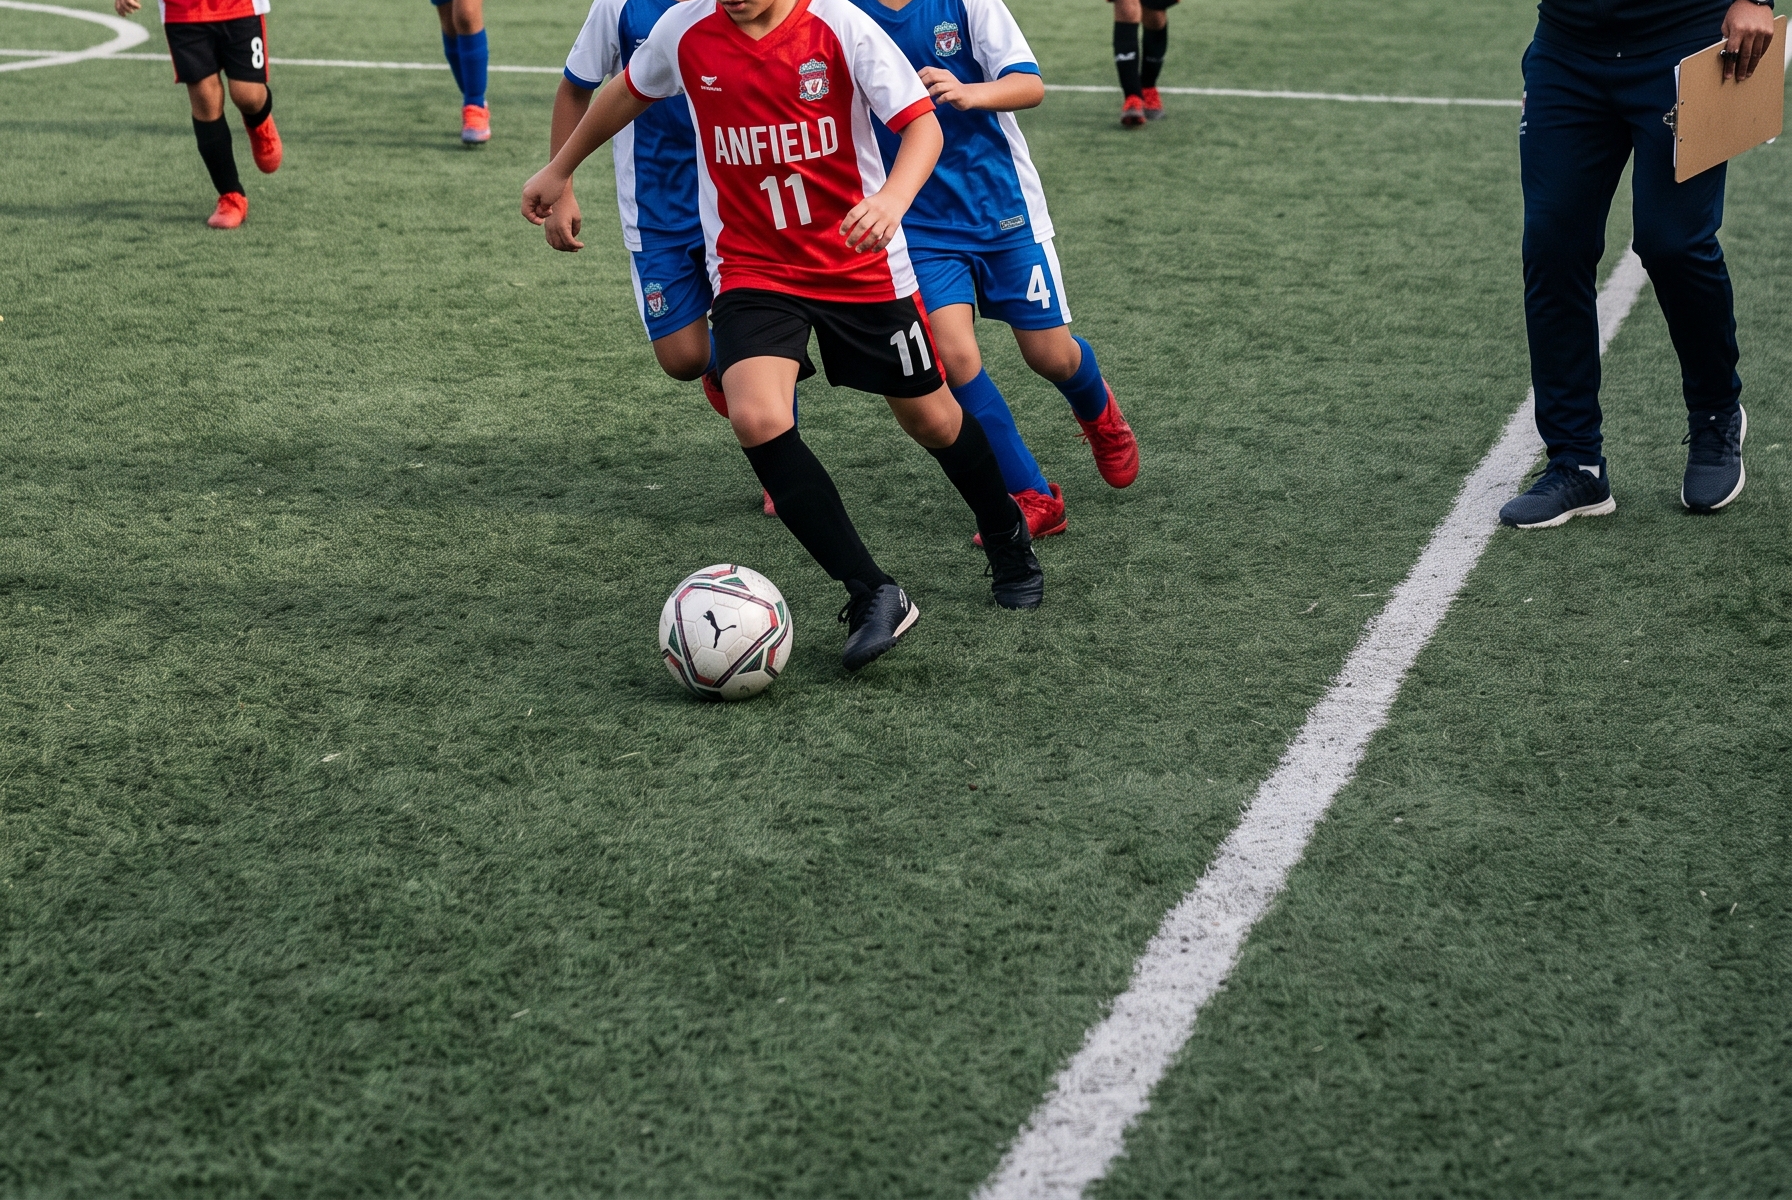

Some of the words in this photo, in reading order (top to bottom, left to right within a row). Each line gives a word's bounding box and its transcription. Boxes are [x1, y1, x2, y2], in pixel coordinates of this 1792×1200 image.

[250, 36, 264, 70] 8
[714, 115, 839, 166] ANFIELD
[759, 173, 812, 230] 11
[1026, 264, 1051, 310] 4
[889, 320, 932, 377] 11
